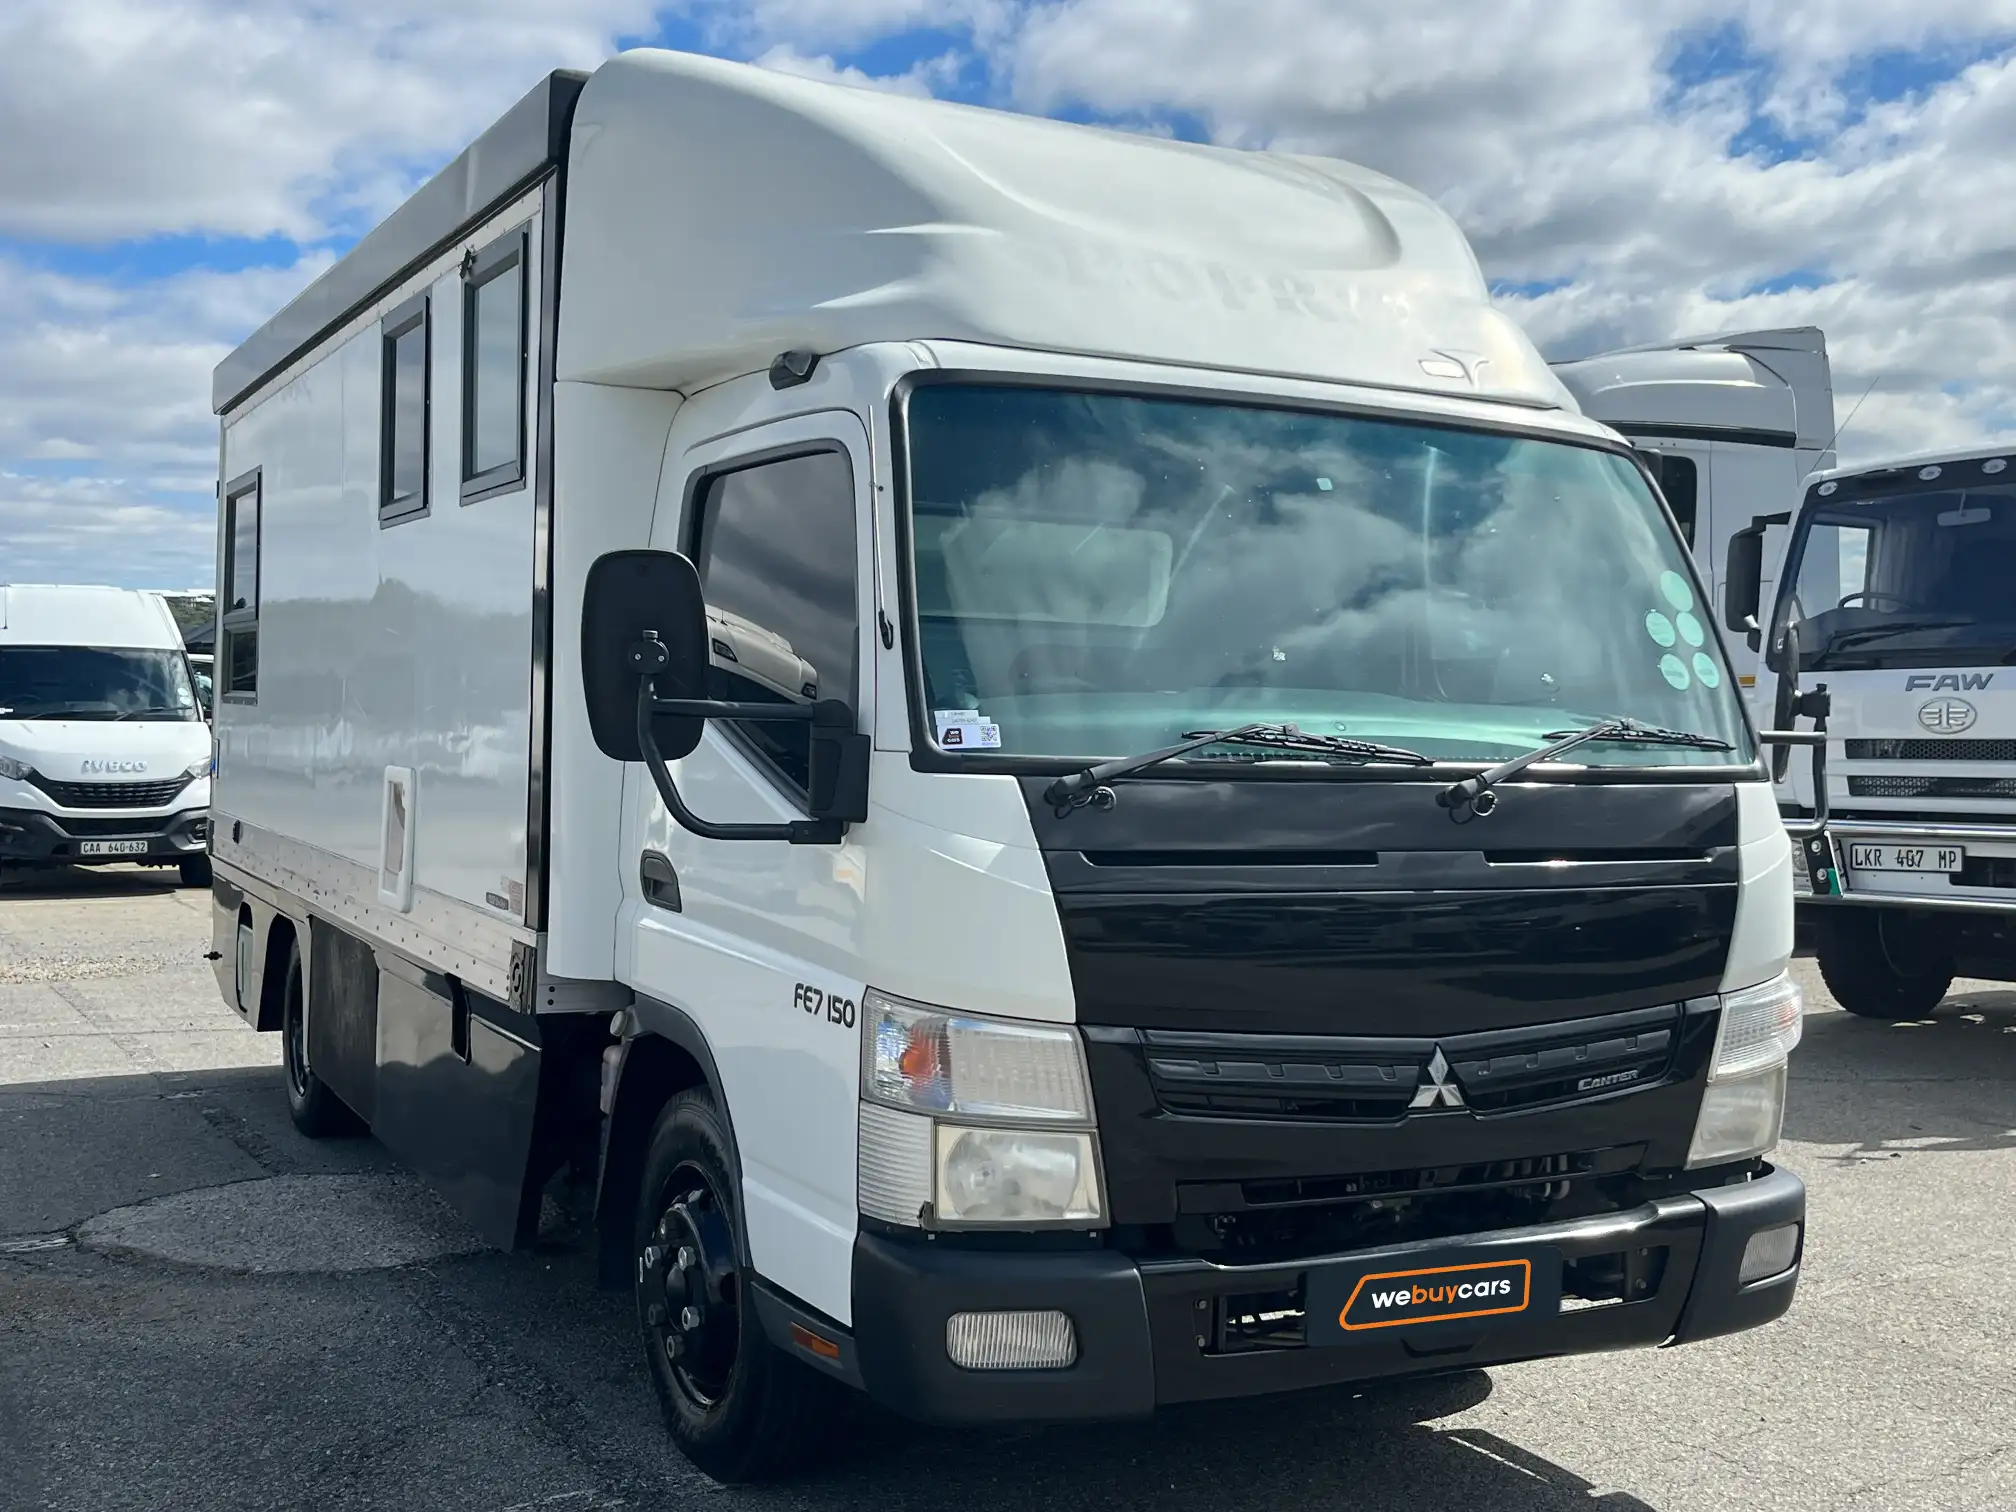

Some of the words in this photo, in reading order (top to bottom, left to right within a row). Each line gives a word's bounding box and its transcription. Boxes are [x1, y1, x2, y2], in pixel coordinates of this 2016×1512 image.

[1905, 673, 1994, 692] FAW
[81, 760, 147, 774] IVECO
[83, 843, 101, 853] CAA
[108, 842, 146, 852] 640-632
[1855, 848, 1882, 867] LKR
[1938, 850, 1957, 869] MP
[794, 982, 823, 1015] FE7
[827, 994, 856, 1029] 150
[1371, 1279, 1511, 1309] webuycars
